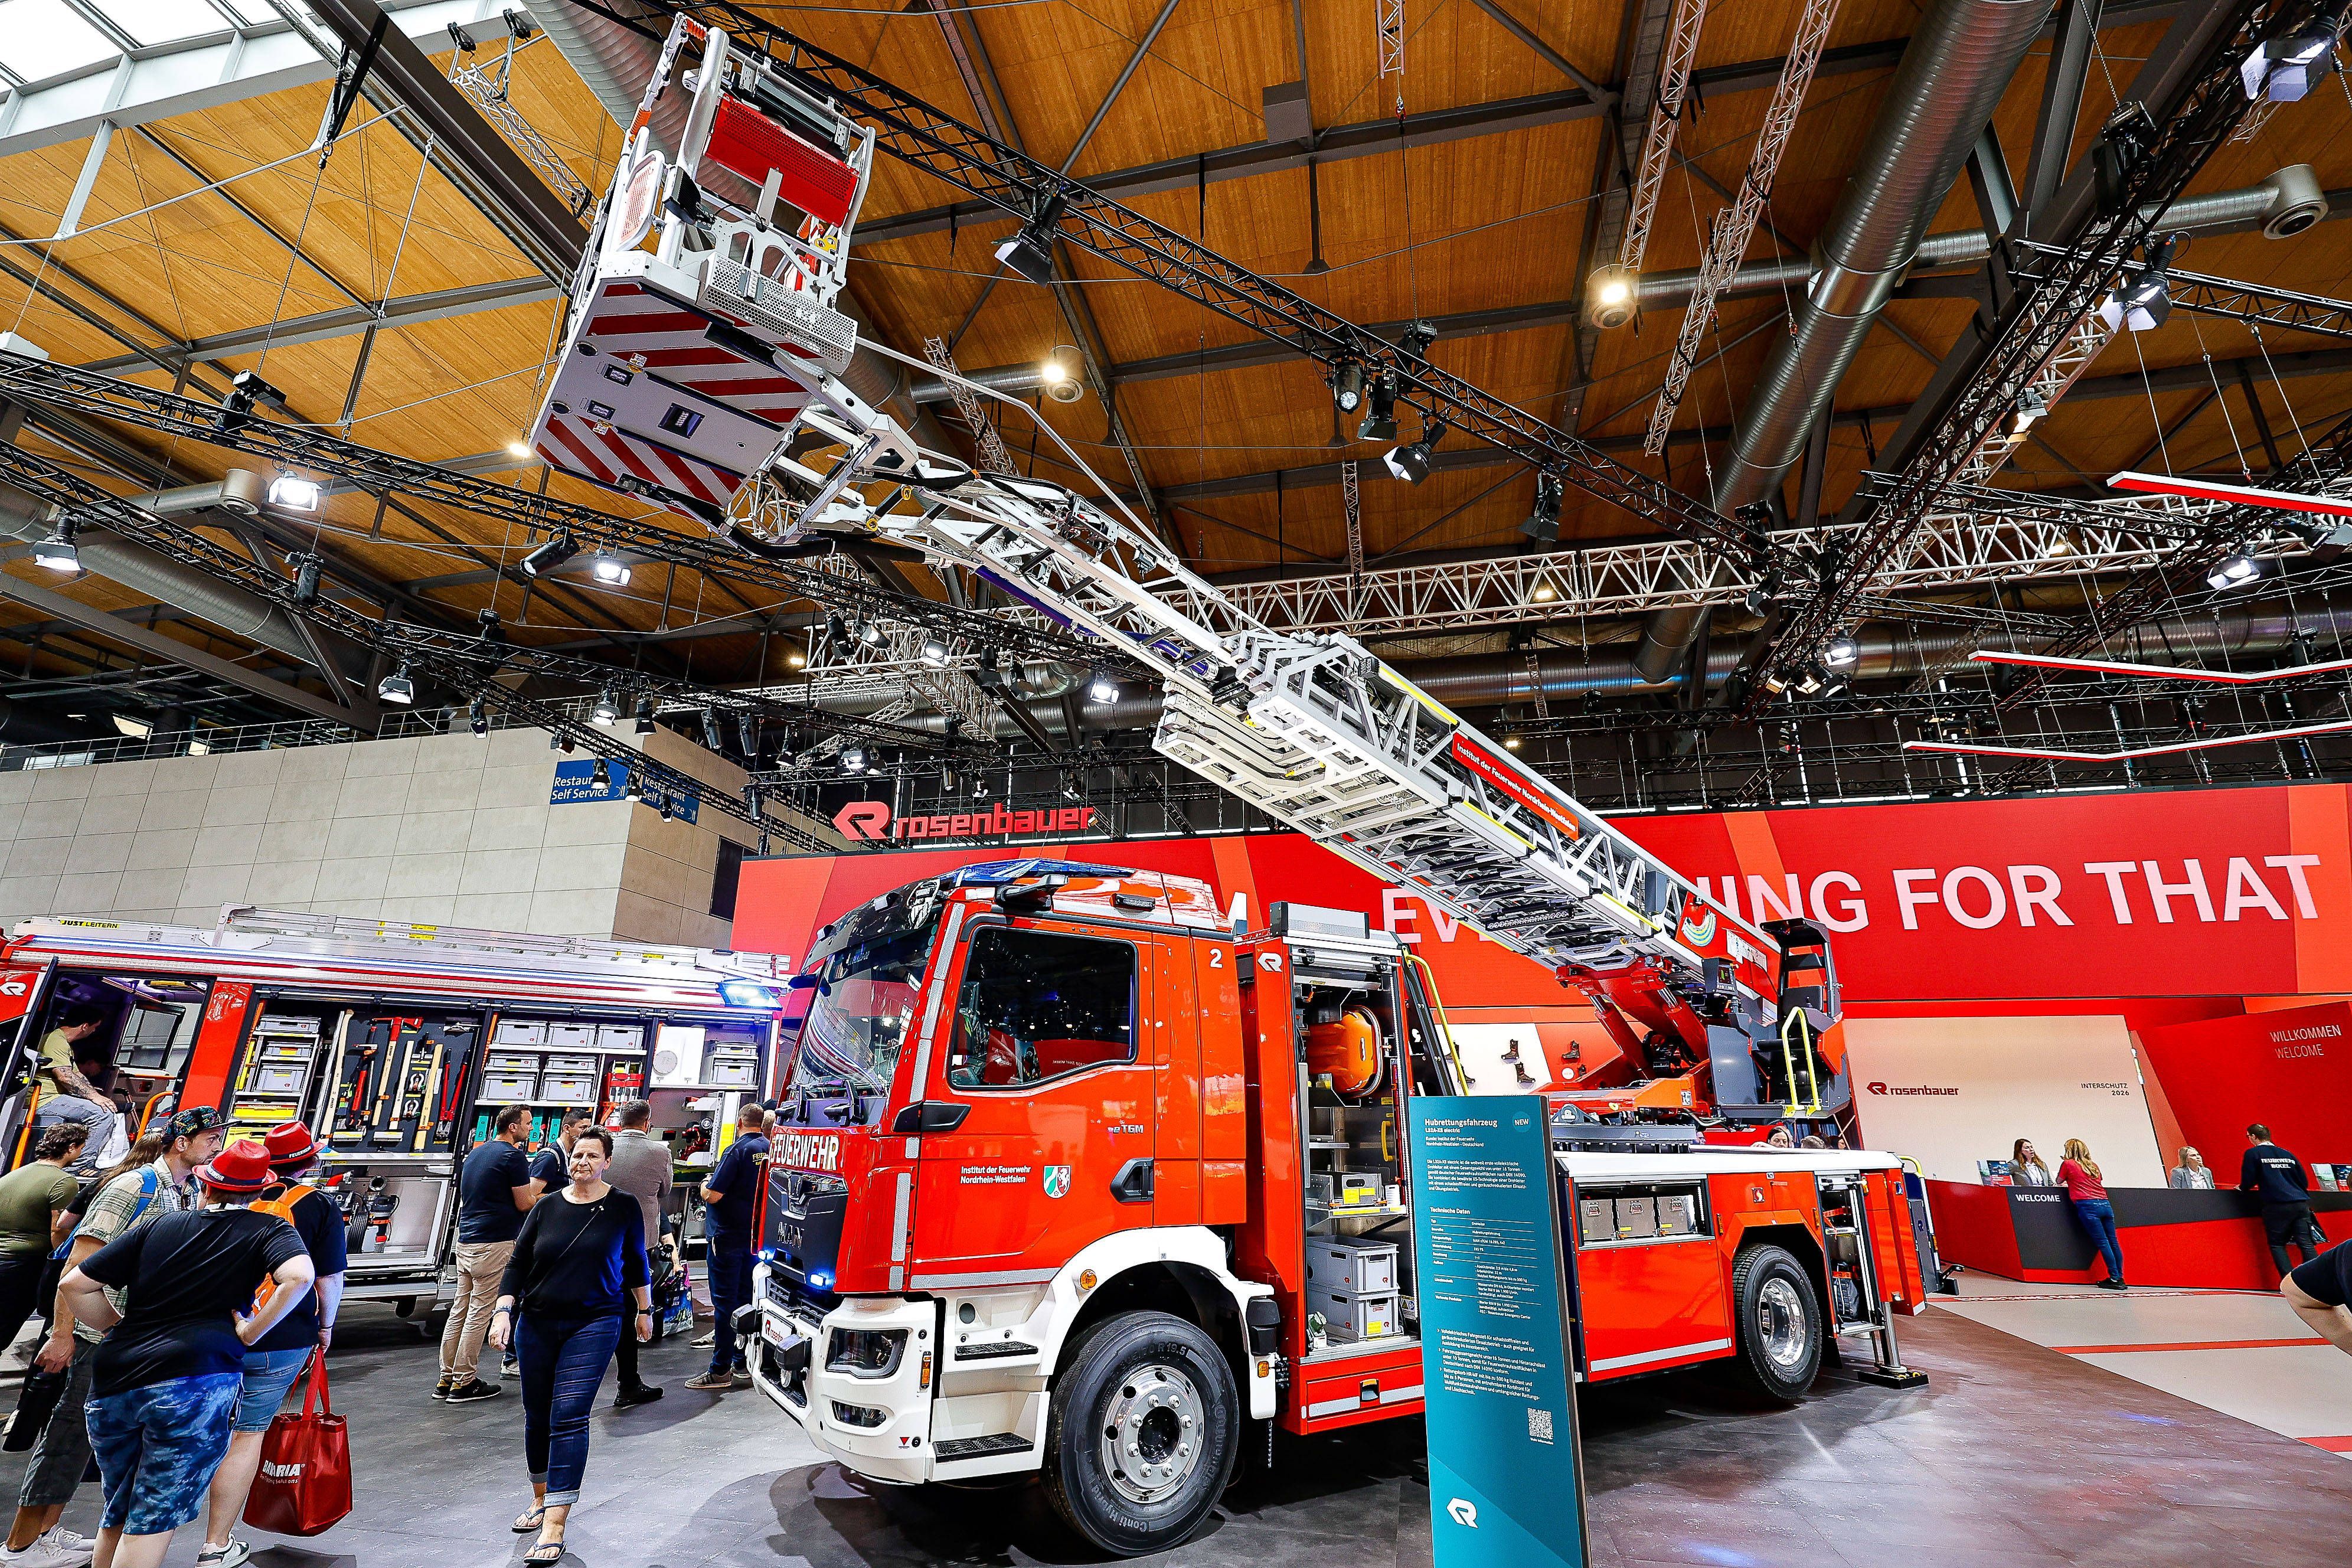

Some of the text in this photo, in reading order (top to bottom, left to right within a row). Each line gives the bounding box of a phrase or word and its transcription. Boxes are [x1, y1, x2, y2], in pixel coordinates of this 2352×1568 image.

[1456, 743, 1480, 765] Institut
[1480, 760, 1491, 772] der
[1491, 766, 1522, 794] Feuerwehr
[554, 776, 593, 787] Restaur
[551, 786, 609, 800] Self Service
[642, 788, 658, 802] Self
[895, 802, 1095, 839] rosenbauer
[1893, 854, 2321, 930] FOR THAT
[1210, 948, 1223, 969] 2
[2270, 1024, 2342, 1043] WILLKOMMEN
[2275, 1044, 2324, 1059] WELCOME
[1890, 1085, 1959, 1096] rosenbauer
[1425, 1118, 1497, 1127] Hubrettungsfahrzeug
[774, 1134, 840, 1171] FEUERWEHR
[961, 1166, 985, 1174] Institut
[998, 1165, 1031, 1174] Feuerwehr
[961, 1175, 1025, 1184] Nordrhein-Westfalen
[2015, 1194, 2061, 1202] WELCOME
